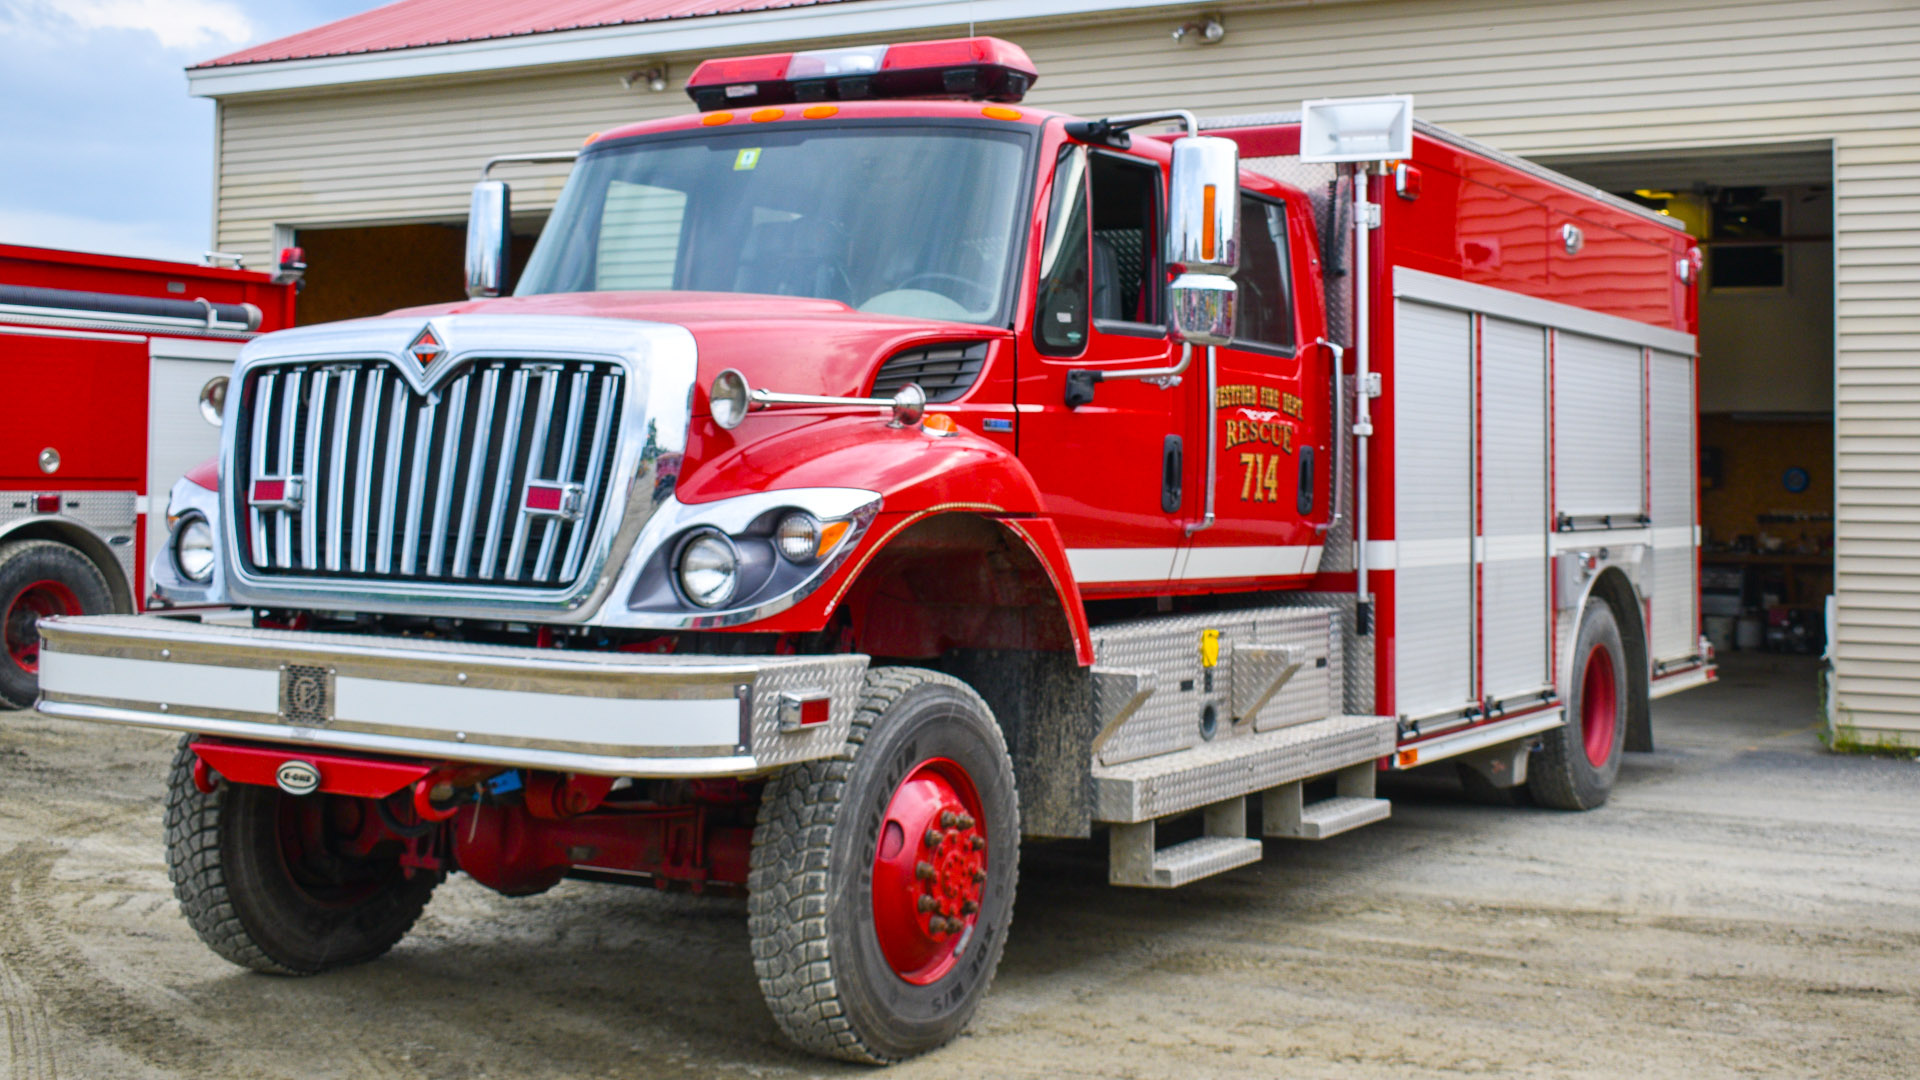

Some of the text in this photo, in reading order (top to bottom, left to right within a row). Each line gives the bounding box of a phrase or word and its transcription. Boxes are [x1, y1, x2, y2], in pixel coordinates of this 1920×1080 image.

[1260, 386, 1280, 410] FIRE
[1225, 419, 1293, 455] RESCUE
[1240, 452, 1279, 503] 714
